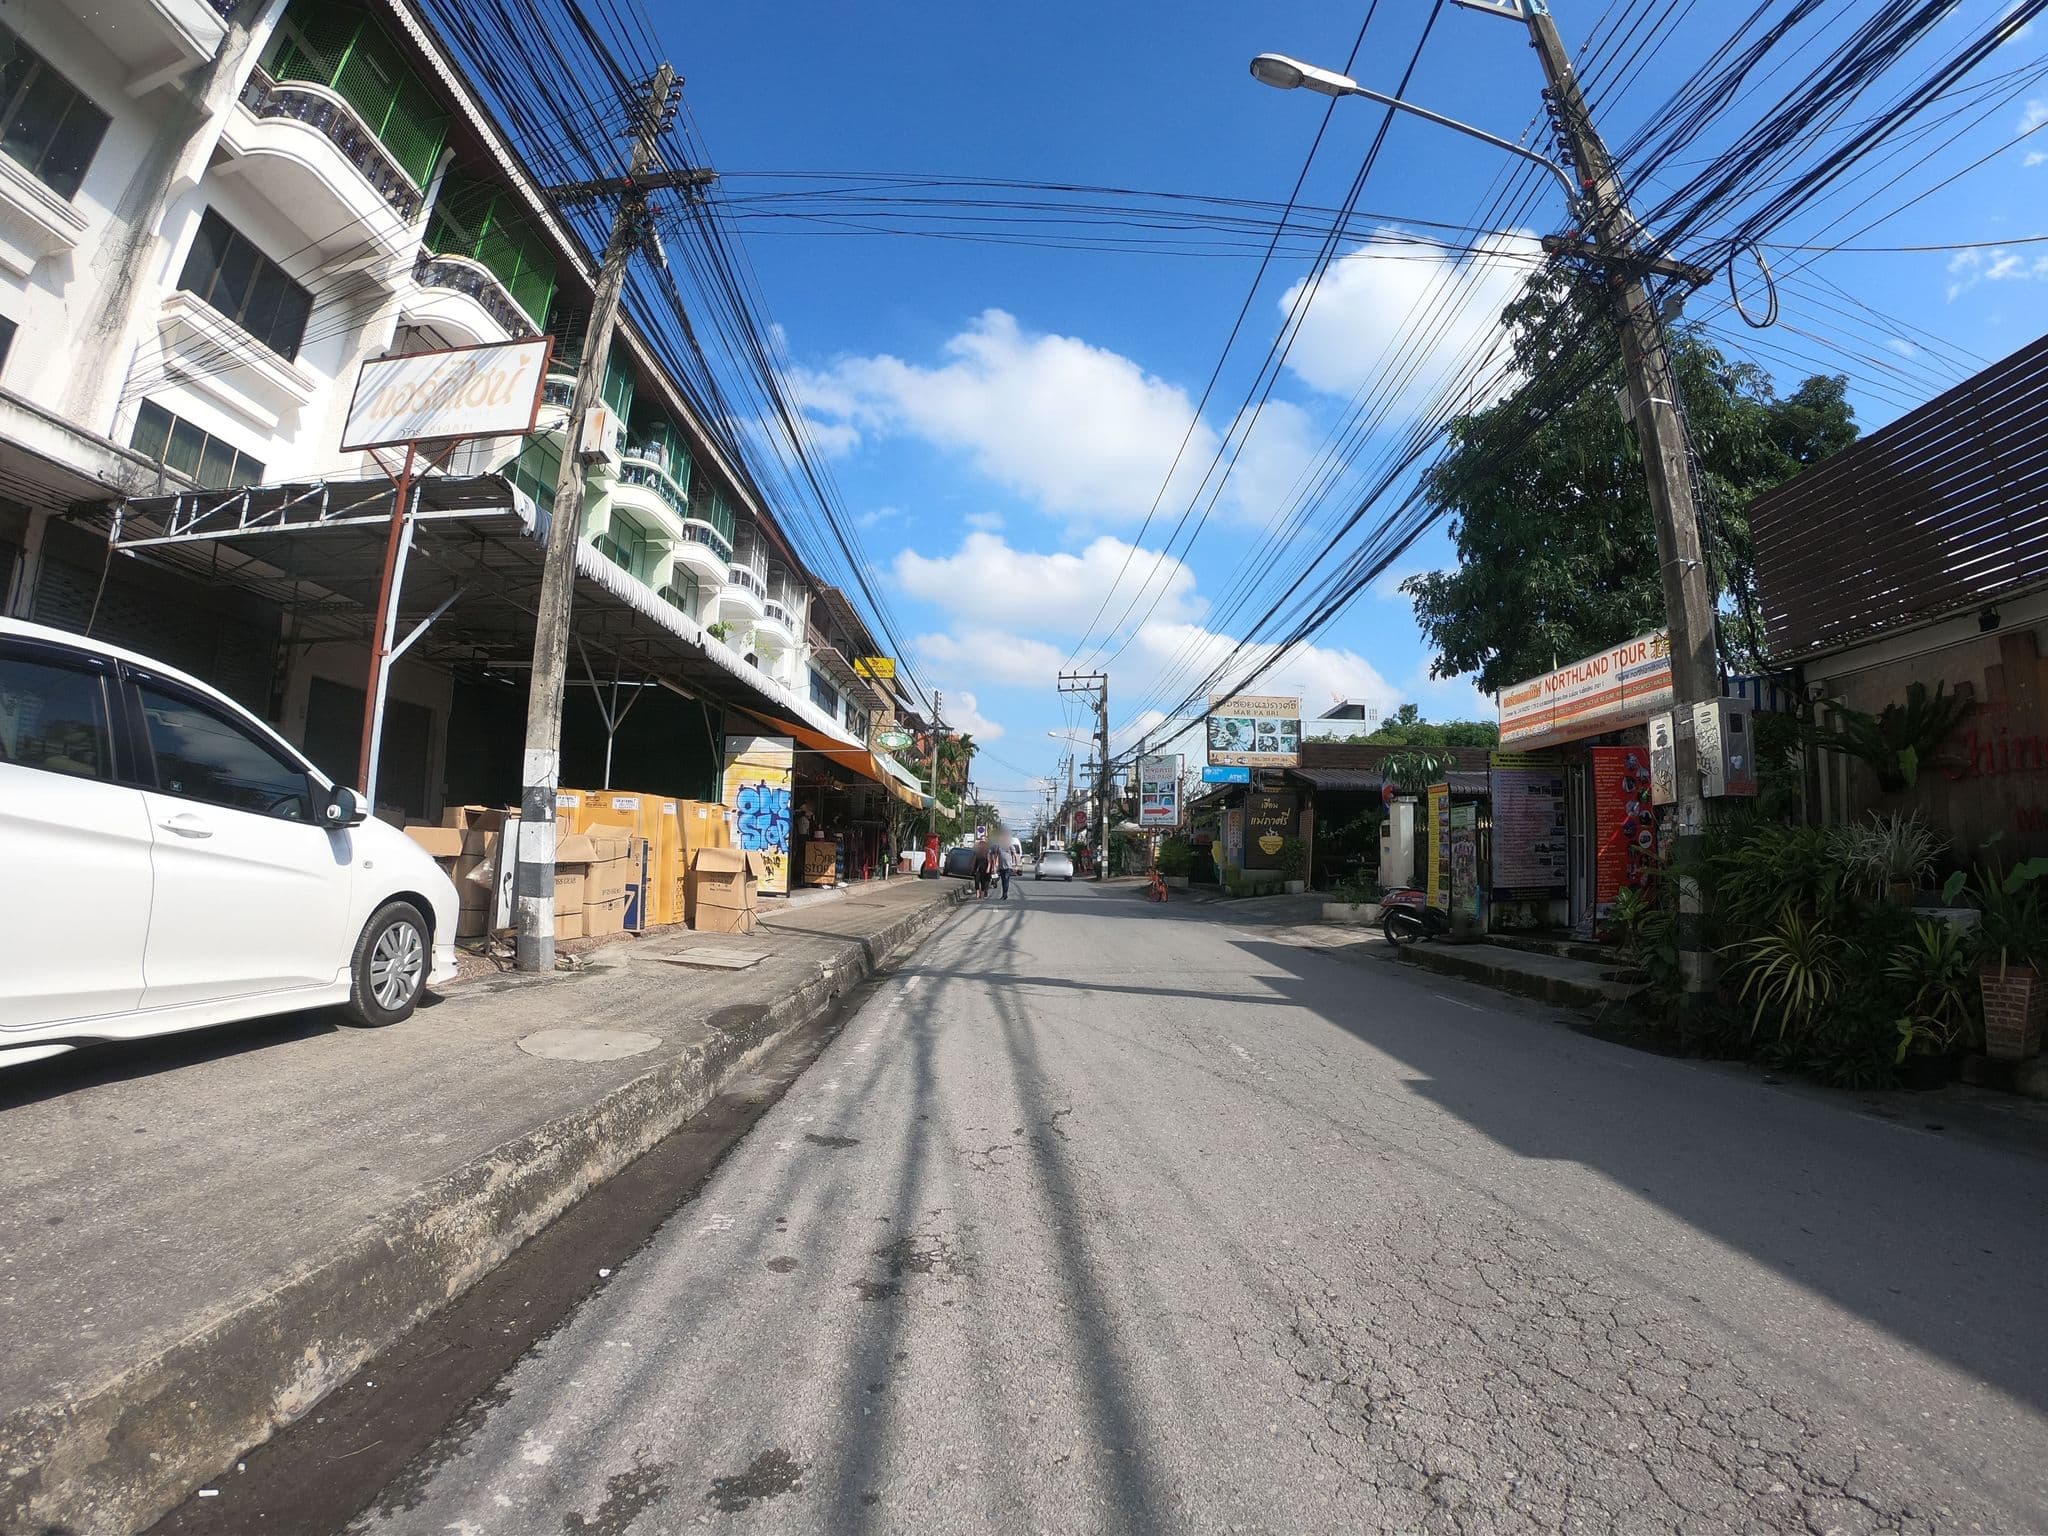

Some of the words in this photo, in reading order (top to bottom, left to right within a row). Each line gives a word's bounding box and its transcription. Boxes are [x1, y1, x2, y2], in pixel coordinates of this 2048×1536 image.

[1544, 657, 1609, 692] NORTHLAND
[1612, 642, 1646, 668] TOUR
[737, 785, 791, 820] ONE
[738, 813, 791, 853] STOP
